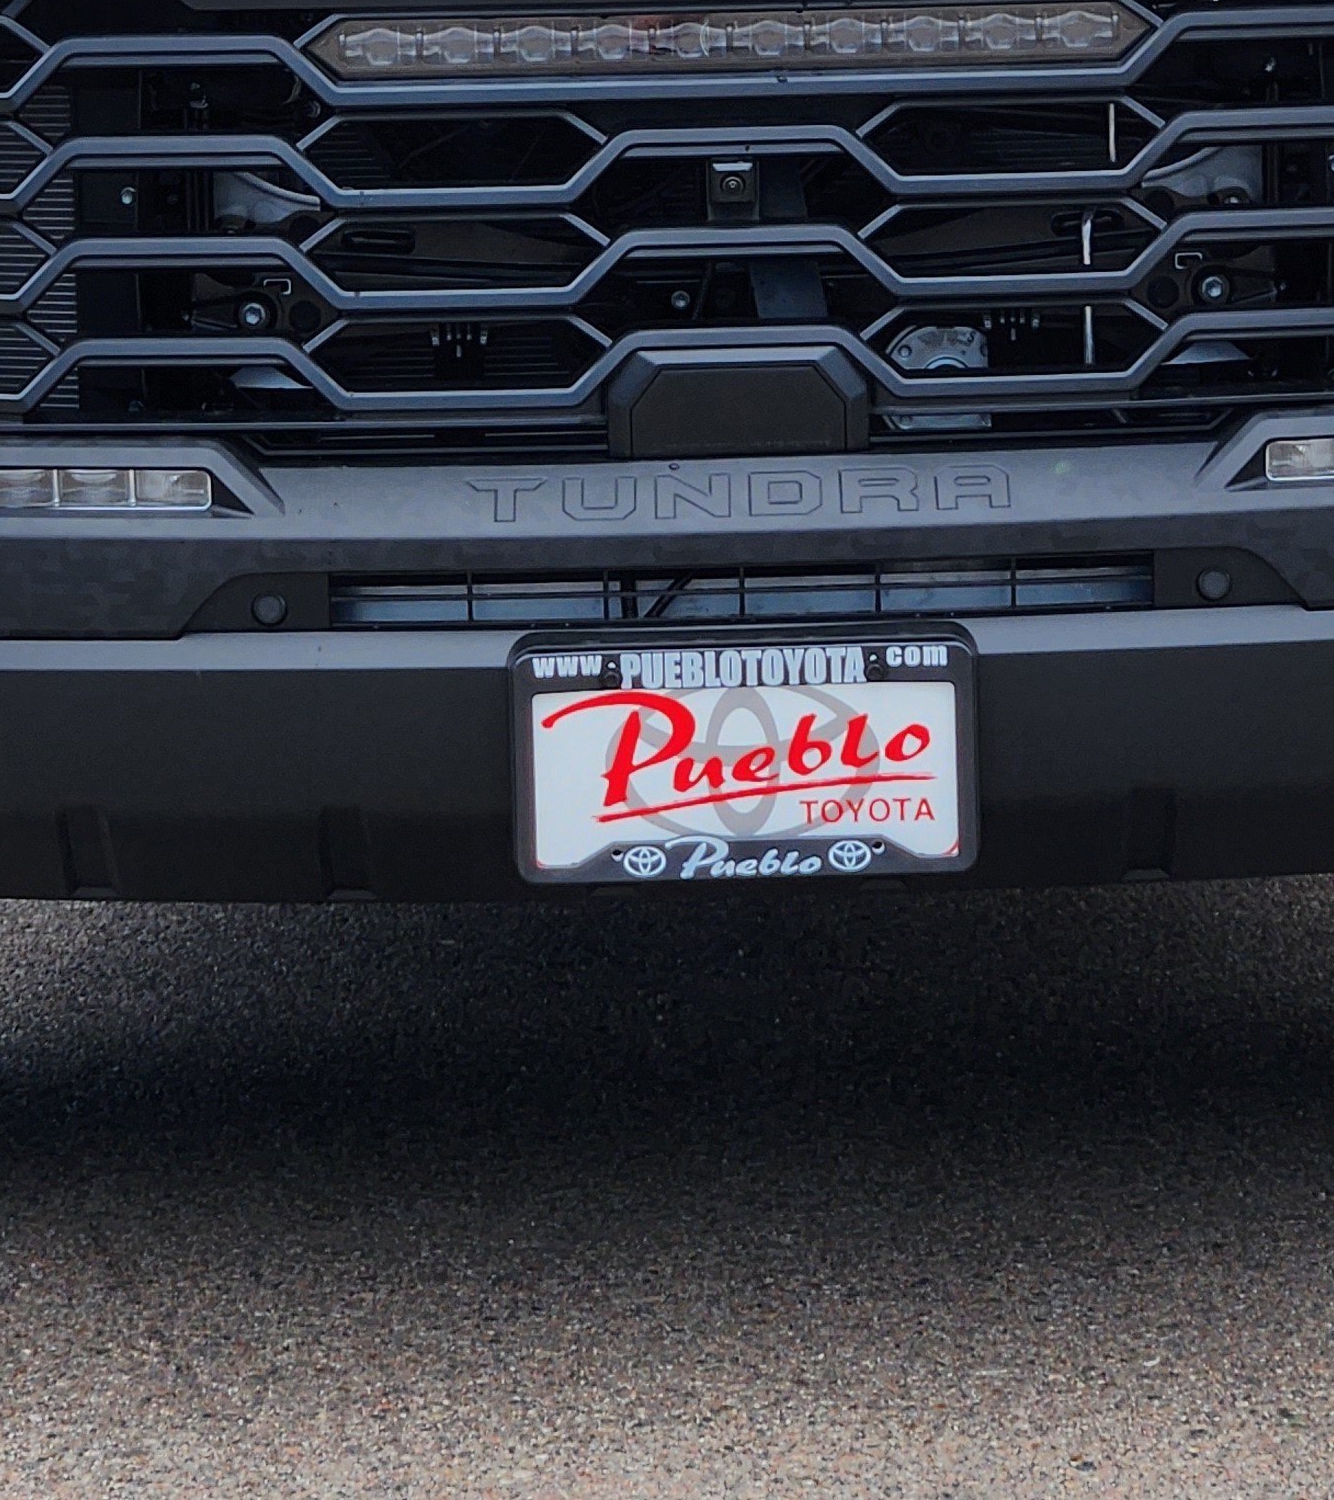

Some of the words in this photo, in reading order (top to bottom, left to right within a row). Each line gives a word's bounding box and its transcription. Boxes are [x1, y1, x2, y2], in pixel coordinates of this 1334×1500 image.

[466, 464, 1012, 523] TUNDRA
[541, 690, 931, 807] Pueblo
[799, 797, 935, 824] TOYOTA
[665, 835, 822, 880] Pueblo
